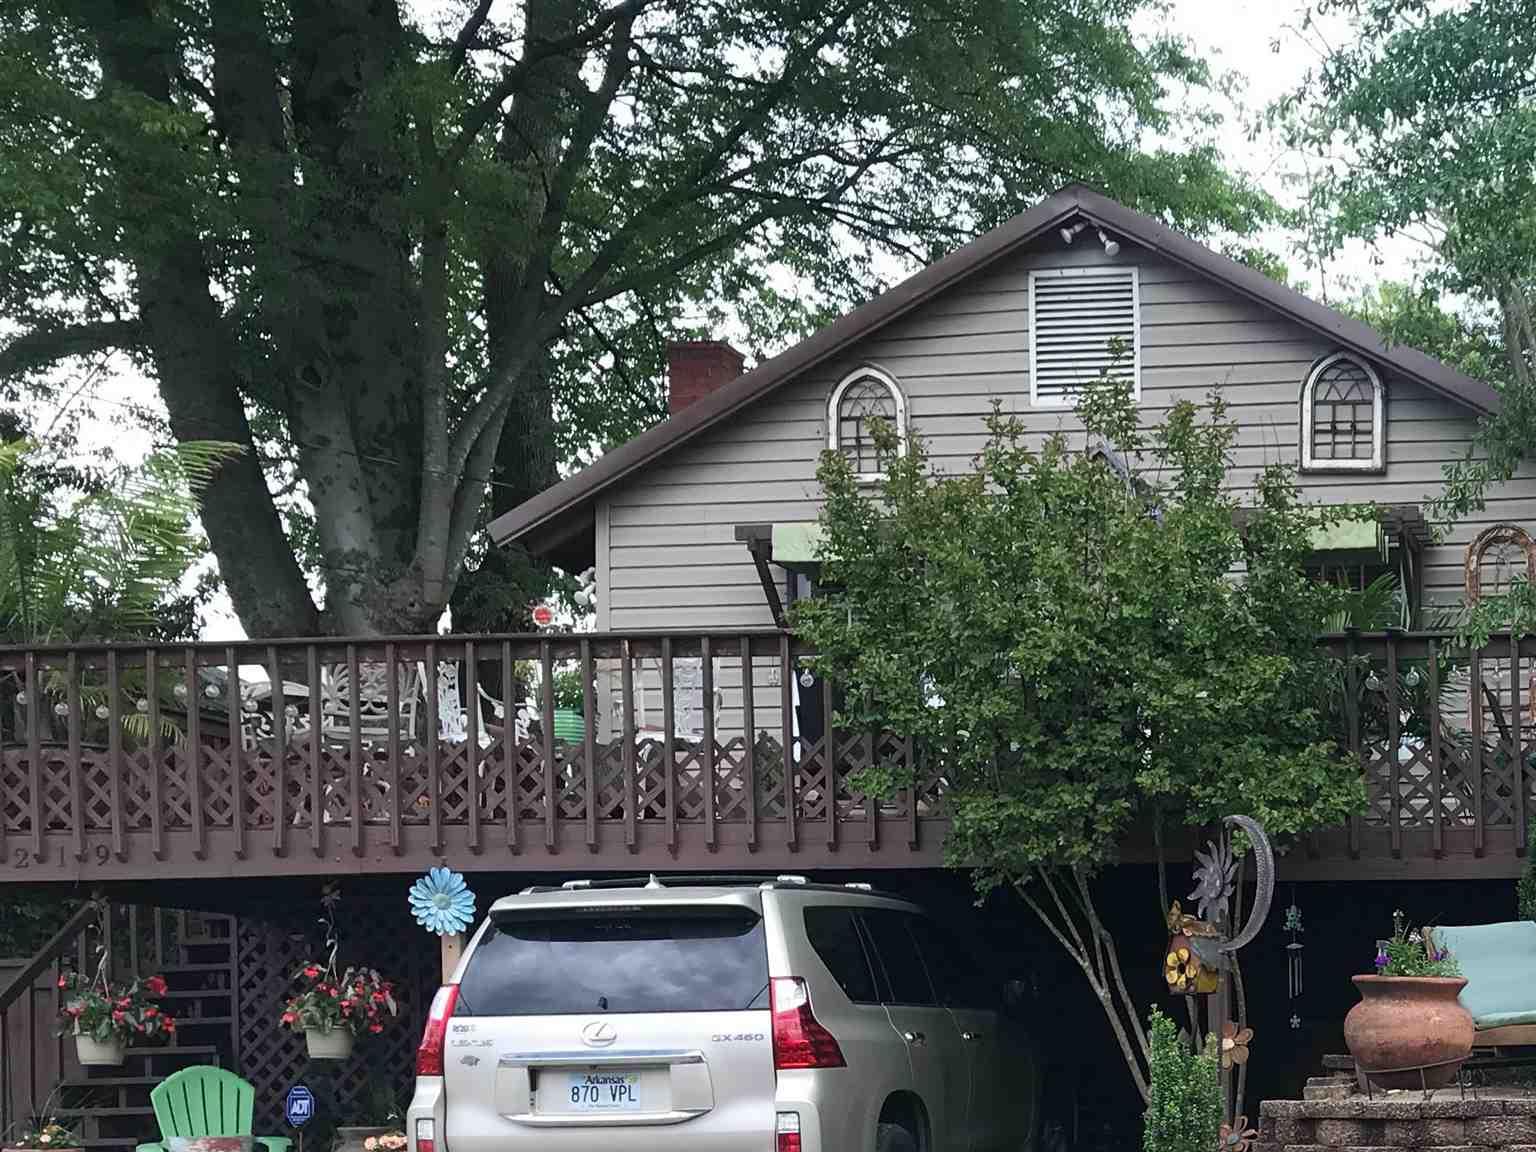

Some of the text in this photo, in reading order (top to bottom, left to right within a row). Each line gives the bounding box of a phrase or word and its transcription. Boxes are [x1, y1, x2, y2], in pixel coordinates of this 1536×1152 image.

[584, 1074, 625, 1085] Arkansas
[571, 1085, 637, 1103] 870 VPL
[290, 1099, 310, 1115] ADT
